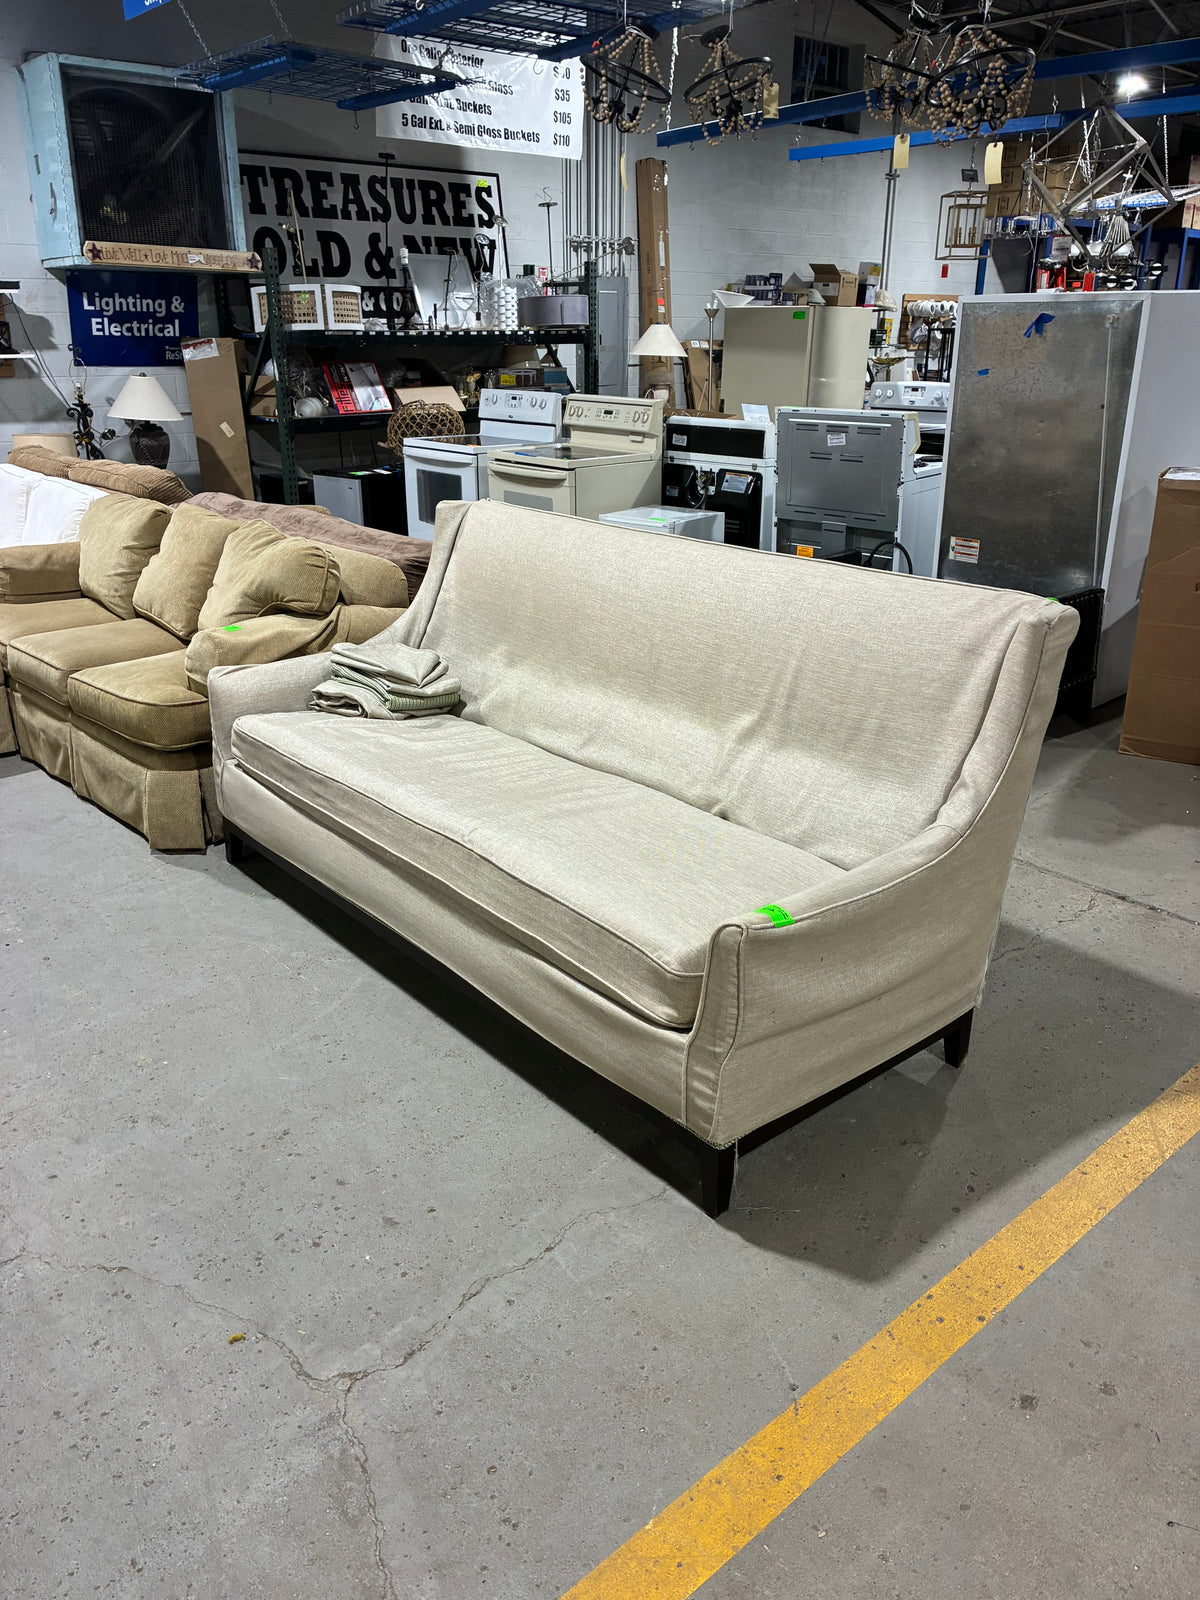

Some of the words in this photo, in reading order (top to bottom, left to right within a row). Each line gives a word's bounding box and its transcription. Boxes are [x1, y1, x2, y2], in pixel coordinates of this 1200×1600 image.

[553, 65, 571, 80] $0
[554, 87, 571, 103] $35
[455, 98, 493, 116] Buckets
[553, 110, 572, 125] $105
[401, 112, 409, 127] 5
[410, 114, 426, 129] Gal
[453, 120, 476, 137] Semi
[477, 124, 503, 140] Gloss
[504, 127, 541, 144] Buckets
[552, 132, 571, 147] $110
[239, 163, 497, 230] TREASURES
[252, 225, 352, 279] OLD
[364, 232, 398, 280] &
[82, 292, 167, 317] Lighting
[170, 295, 185, 313] &
[91, 317, 180, 337] Electrical
